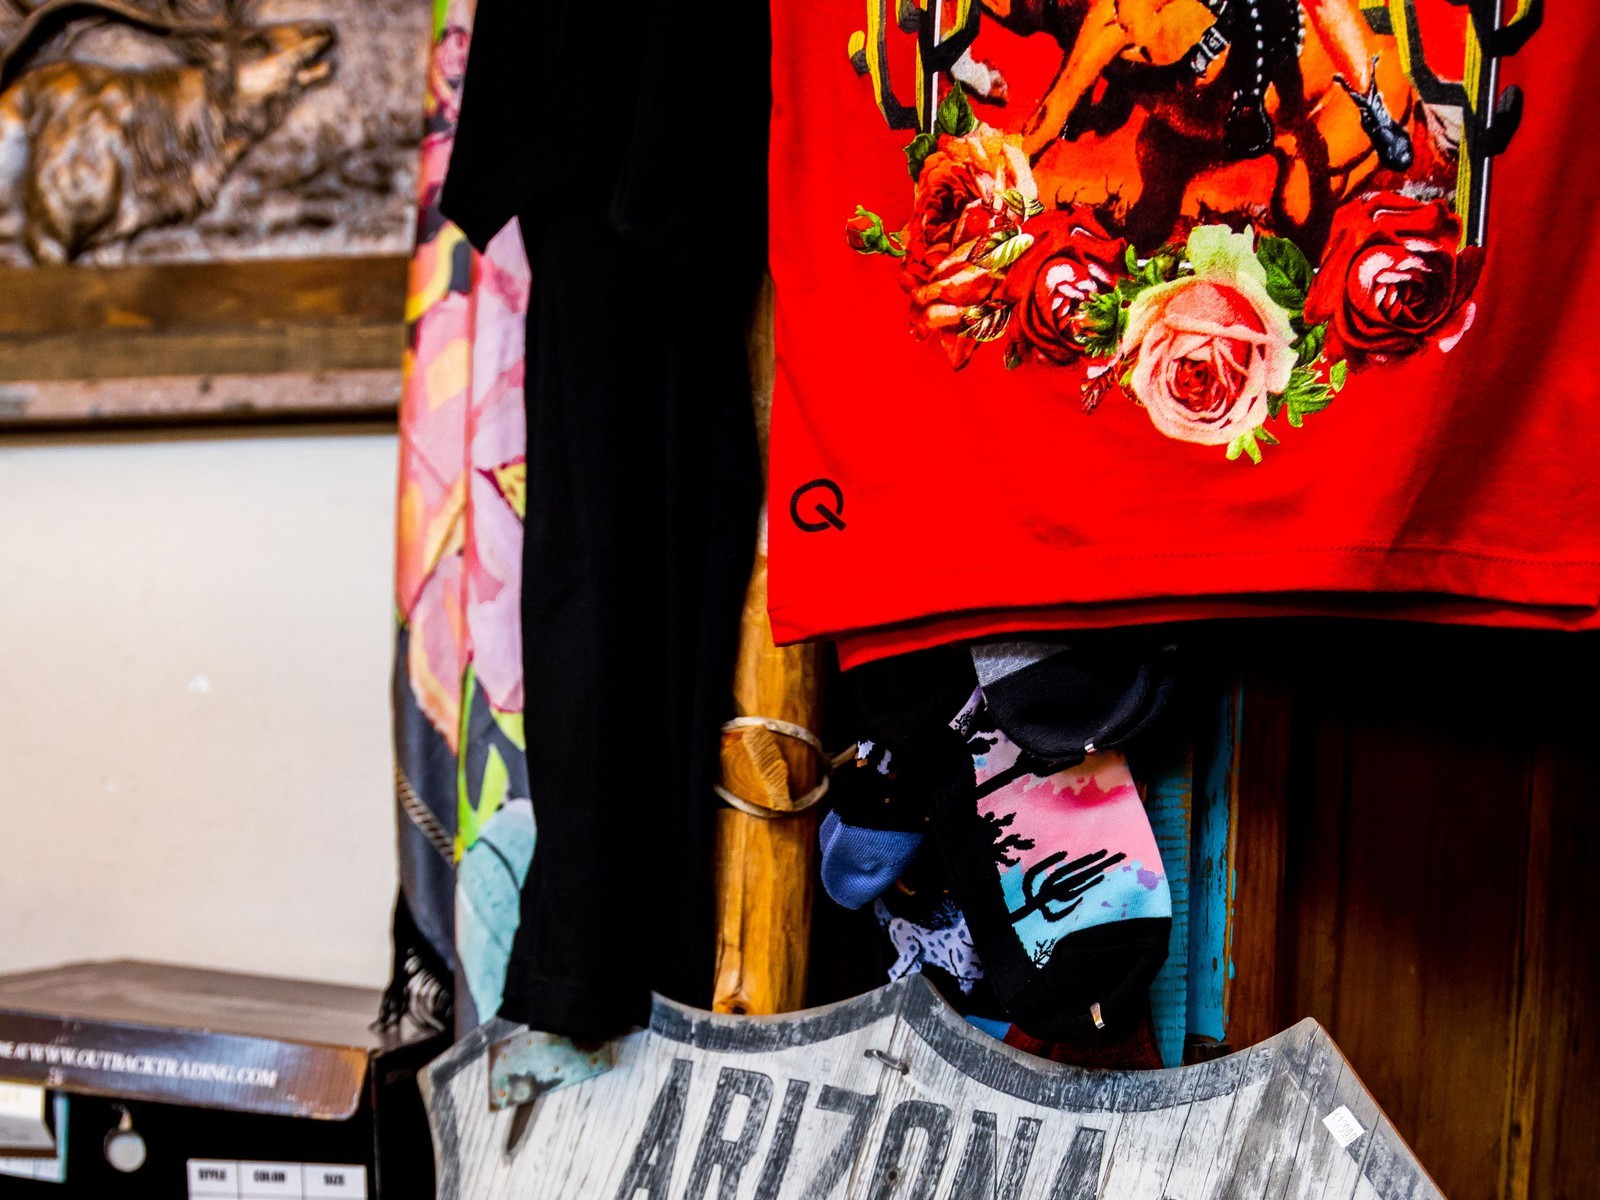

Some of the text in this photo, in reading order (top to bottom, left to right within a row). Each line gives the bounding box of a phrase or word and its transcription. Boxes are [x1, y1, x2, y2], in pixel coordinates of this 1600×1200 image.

[789, 478, 847, 533] Q
[29, 1043, 279, 1089] WWW.OUTBACKTRADING.COM
[197, 1167, 346, 1187] STYLE COLOR SIZE
